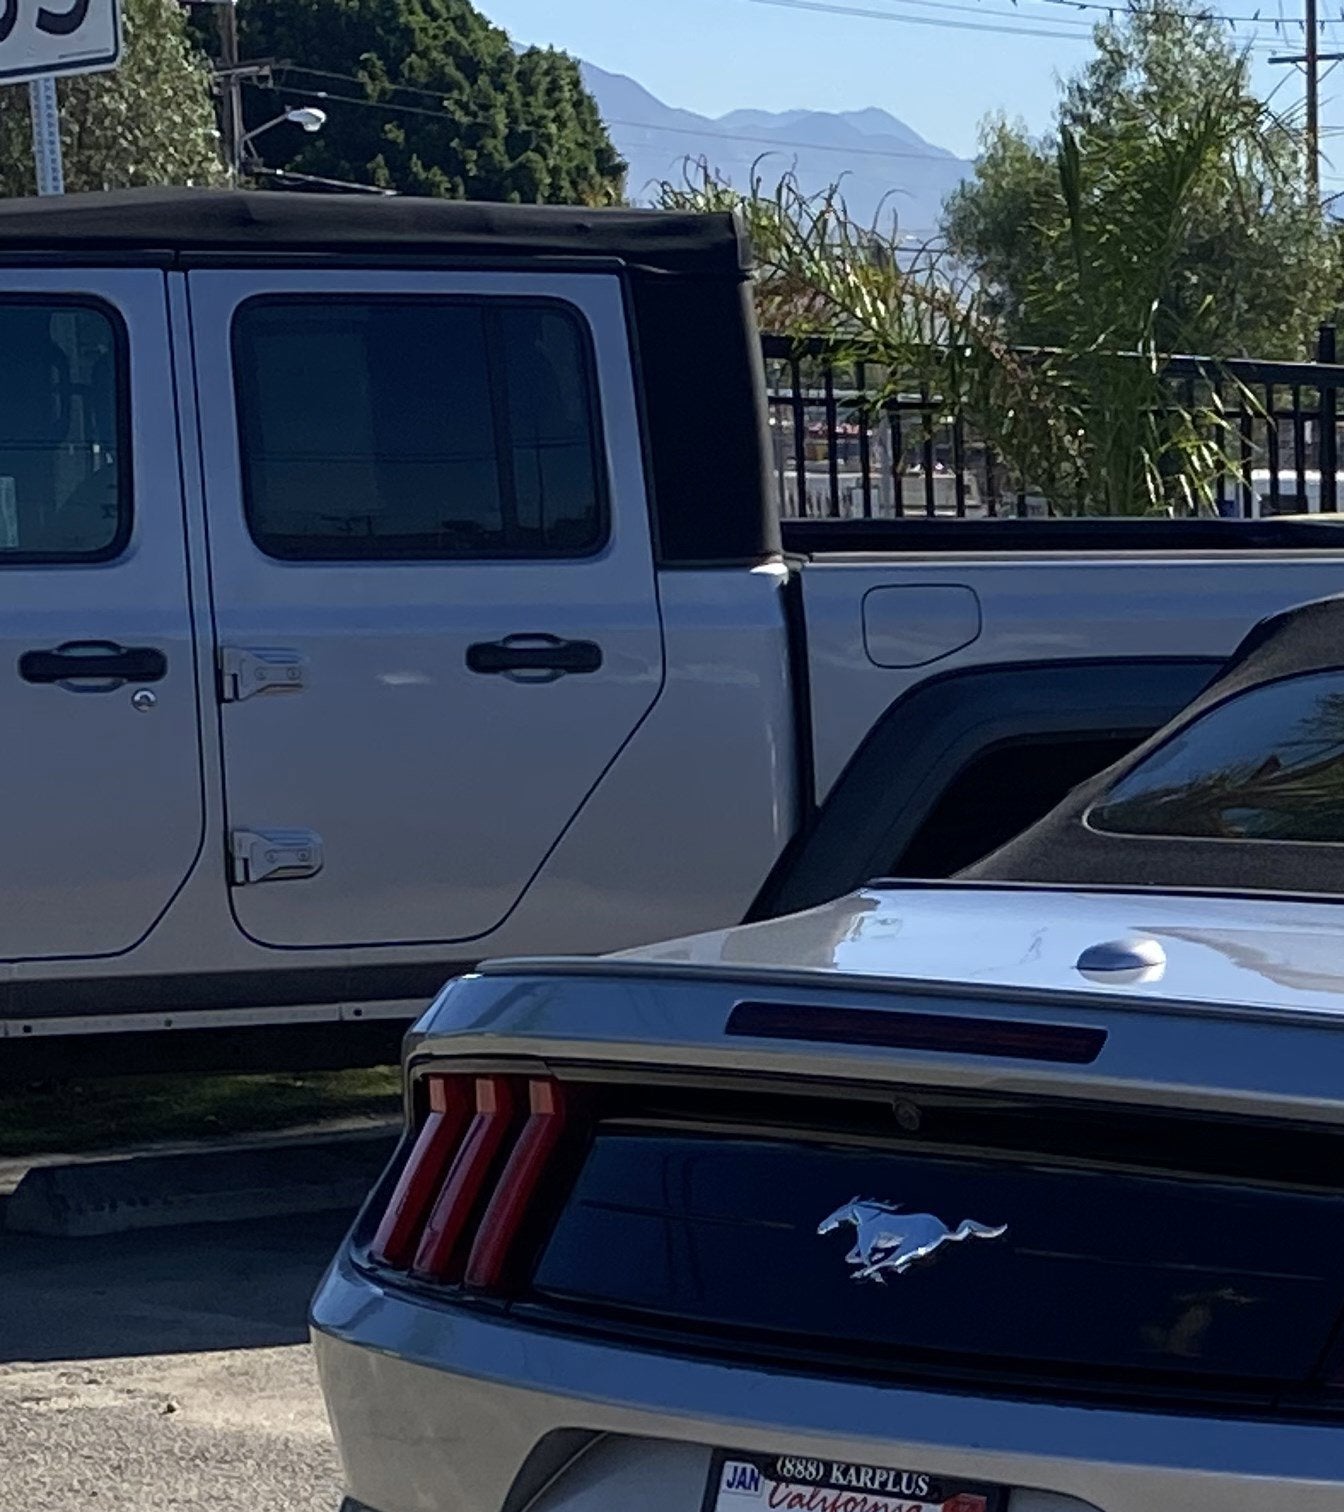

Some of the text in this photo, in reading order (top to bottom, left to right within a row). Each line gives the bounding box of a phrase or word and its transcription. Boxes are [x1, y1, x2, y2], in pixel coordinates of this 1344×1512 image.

[726, 1464, 760, 1492] JAN
[776, 1456, 929, 1496] (888) KARPLUS
